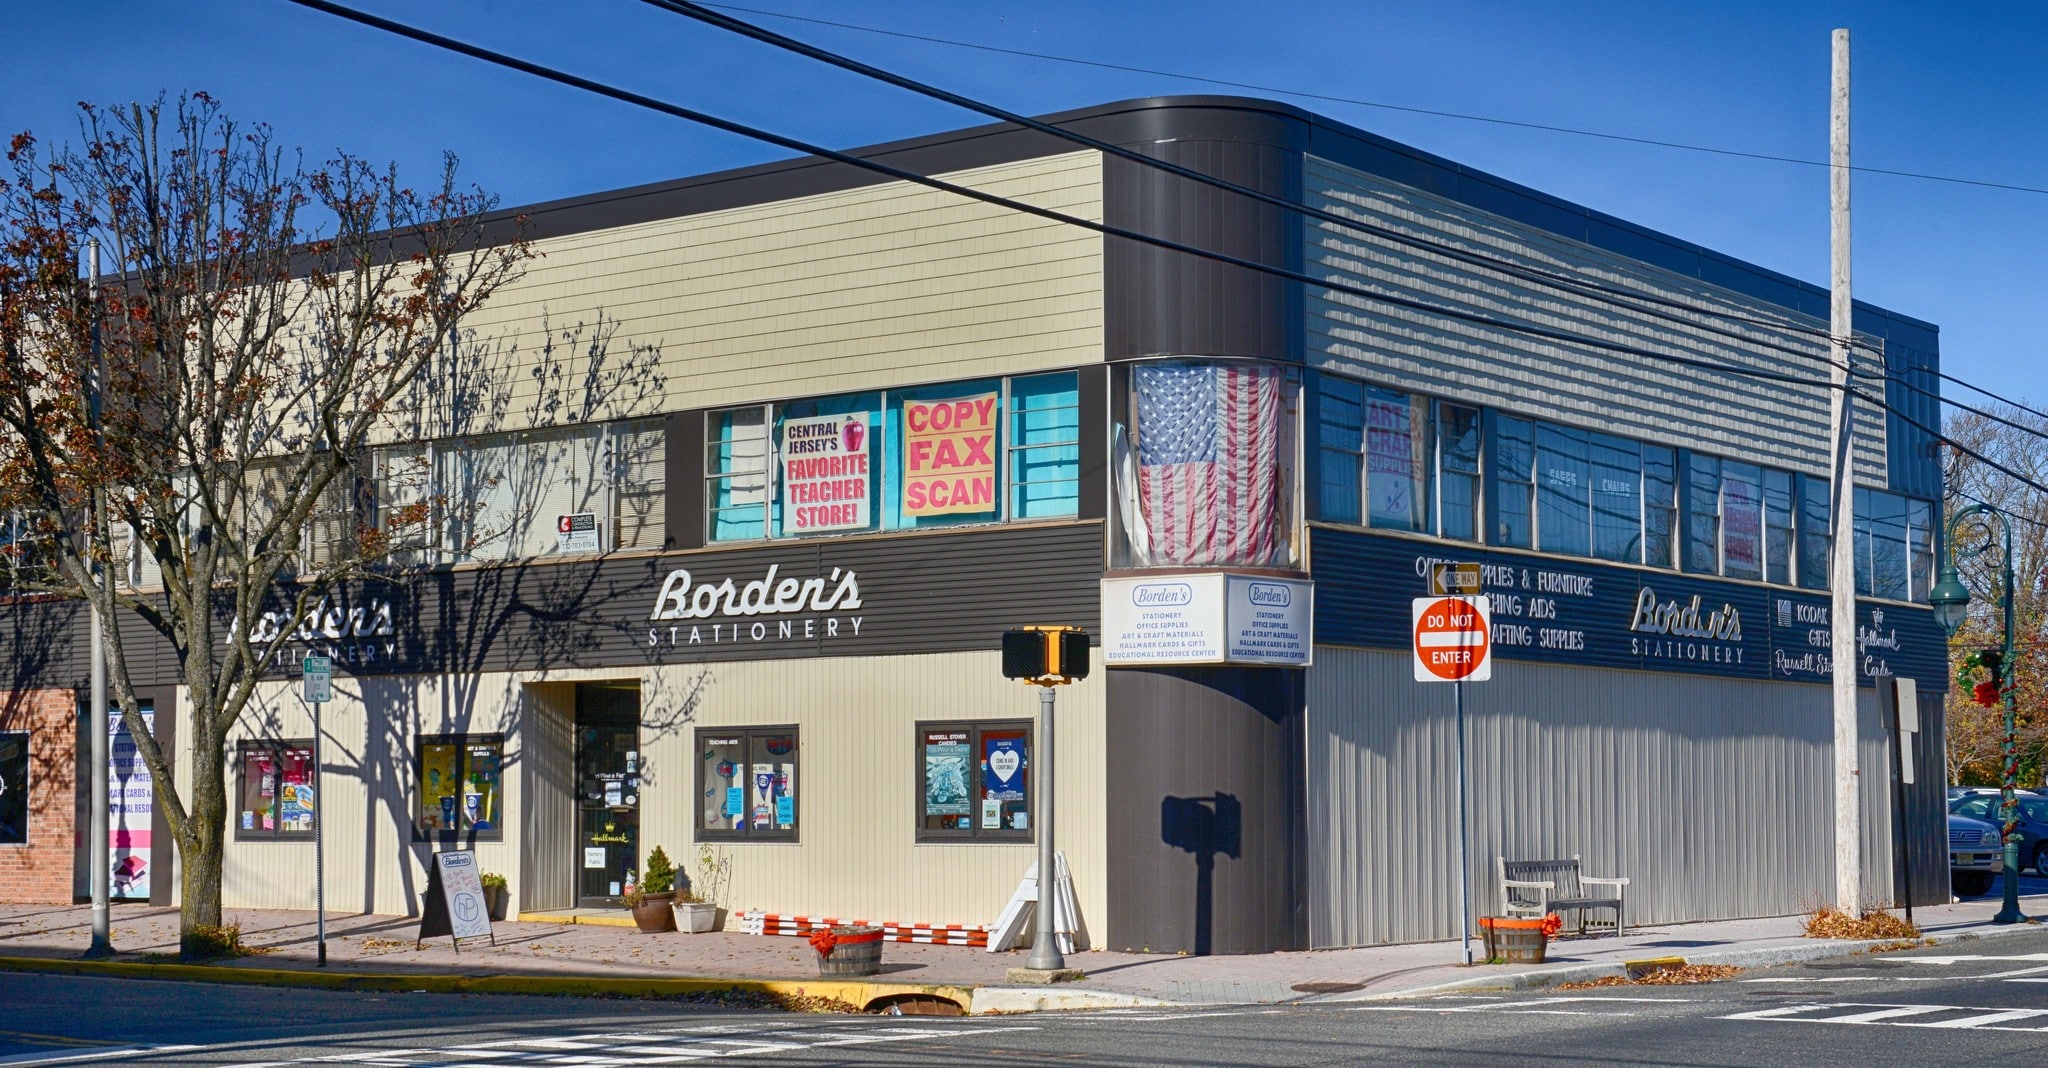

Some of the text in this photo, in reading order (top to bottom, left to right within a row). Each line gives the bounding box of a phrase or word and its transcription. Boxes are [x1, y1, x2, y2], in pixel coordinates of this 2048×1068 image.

[909, 398, 995, 432] COPY
[1367, 400, 1403, 428] ART
[788, 422, 839, 439] CENTRAL
[788, 437, 838, 455] JERSEY'S
[910, 435, 993, 471] FAX
[787, 453, 868, 481] FAVORITE
[1368, 455, 1422, 477] SUPPLIES
[789, 478, 865, 505] TEACHER
[907, 476, 993, 510] SCAN
[796, 503, 858, 529] STORE!
[1446, 572, 1476, 586] ONE WAY
[1480, 565, 1514, 588] PPLIES
[1521, 570, 1531, 589] &
[1538, 571, 1594, 597] FURNITURE
[650, 563, 863, 621] Borden's
[1138, 587, 1188, 603] Borden's
[1253, 587, 1288, 604] Borden's
[1142, 612, 1182, 620] STATIONERY
[1256, 611, 1285, 620] STATIONERY
[1529, 598, 1556, 620] AIDS
[1797, 604, 1829, 625] KODAK
[1160, 621, 1189, 629] SUPPLIES
[1252, 620, 1289, 630] OFFICE SUPPLIES
[1427, 614, 1473, 628] DO NOT
[648, 616, 863, 647] STATIONERY
[1121, 632, 1134, 640] ART
[1143, 631, 1164, 639] CRAFT
[1165, 630, 1204, 638] MATERIALS
[1273, 631, 1298, 640] MATERIALS
[1490, 624, 1584, 651] AFTING SUPPLIES
[1808, 629, 1831, 648] GIFTS
[1856, 625, 1901, 655] Hallmark
[1232, 648, 1305, 659] EDUCATIONAL RESOURCE CENTER
[1239, 639, 1266, 647] HALLMARK
[1267, 640, 1282, 648] CARDS
[1287, 641, 1299, 649] GIFTS
[1632, 637, 1743, 664] STATIONERY
[1109, 649, 1216, 659] EDUCATIONAL RESOURCE CENTER
[1431, 651, 1471, 664] ENTER
[1775, 648, 1815, 676] Russell
[1864, 654, 1894, 677] Cards
[126, 787, 145, 799] CARDS
[146, 789, 151, 798] &
[591, 832, 630, 846] Hallmark
